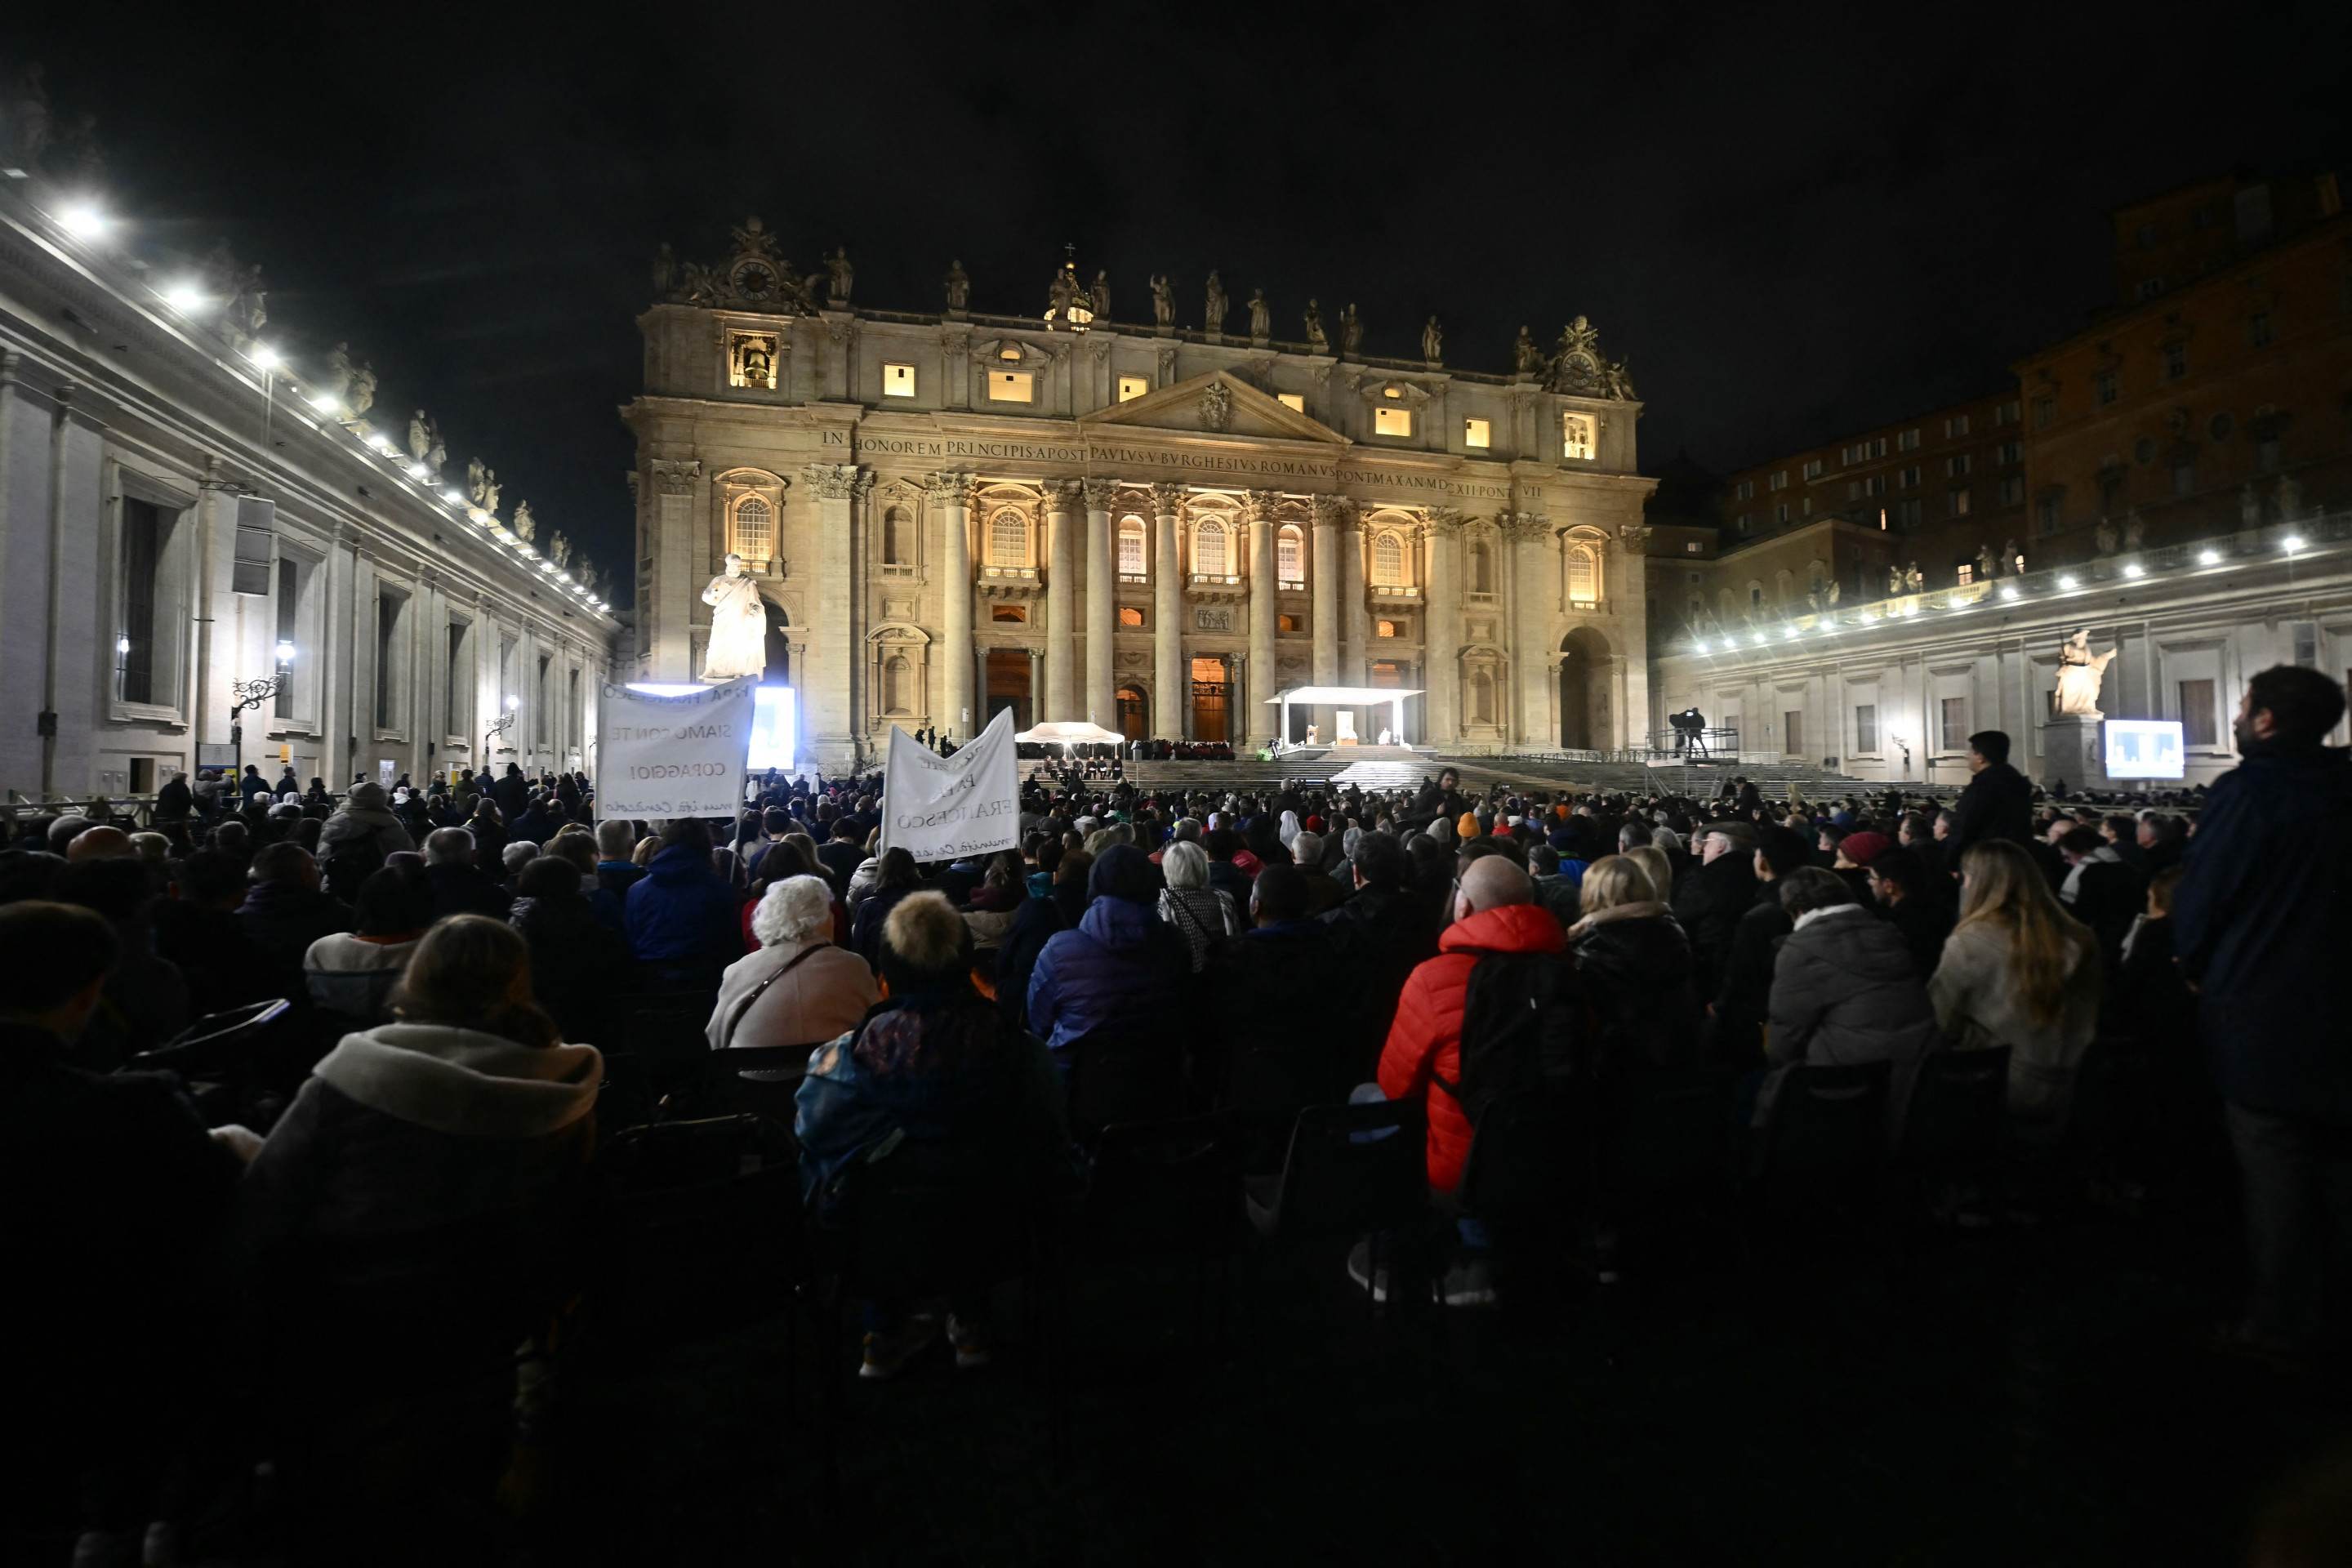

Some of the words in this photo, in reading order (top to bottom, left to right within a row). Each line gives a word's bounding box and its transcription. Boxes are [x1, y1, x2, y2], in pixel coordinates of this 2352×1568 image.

[823, 432, 843, 444] IN
[855, 439, 941, 456] HONOREM
[1261, 461, 1334, 477] ROMANVS
[1523, 486, 1540, 497] VII
